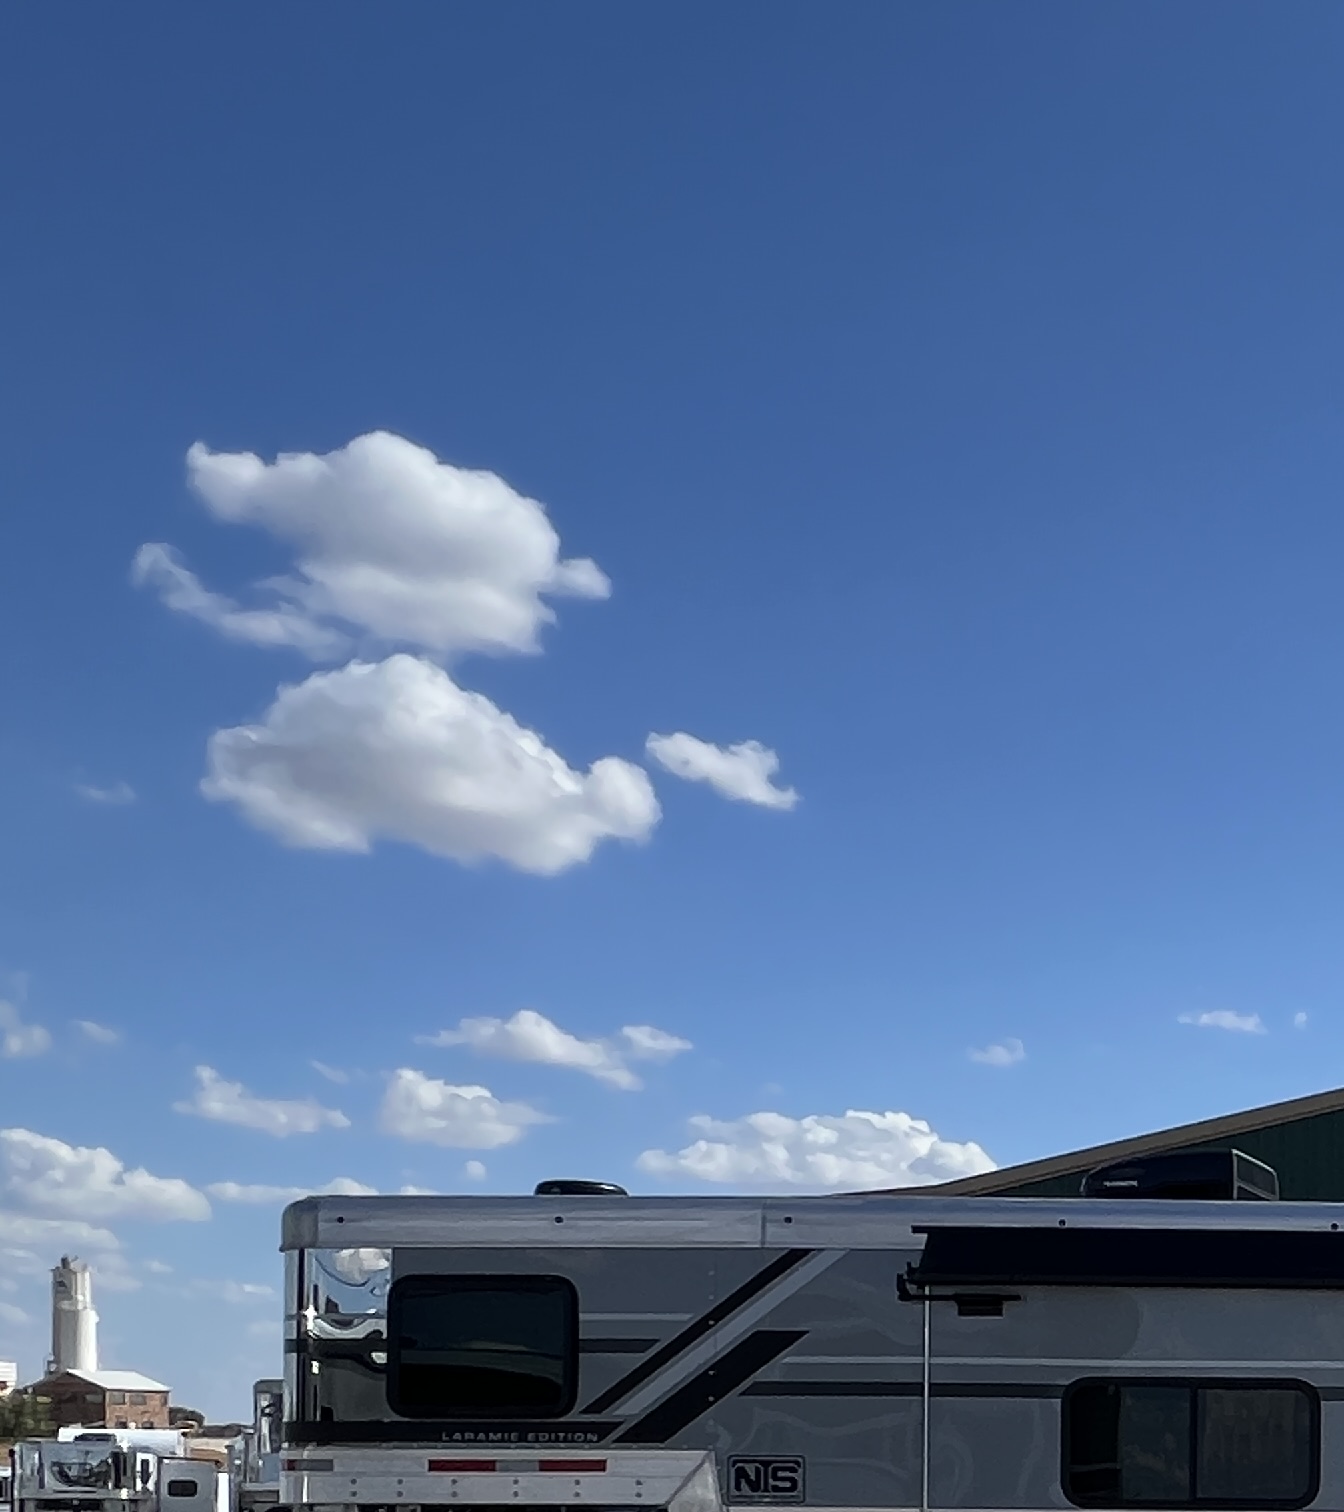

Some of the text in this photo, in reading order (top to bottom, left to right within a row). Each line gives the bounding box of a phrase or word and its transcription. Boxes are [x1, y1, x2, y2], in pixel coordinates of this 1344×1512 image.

[441, 1431, 599, 1442] LARAMIE EDITION
[732, 1459, 802, 1493] NTS
